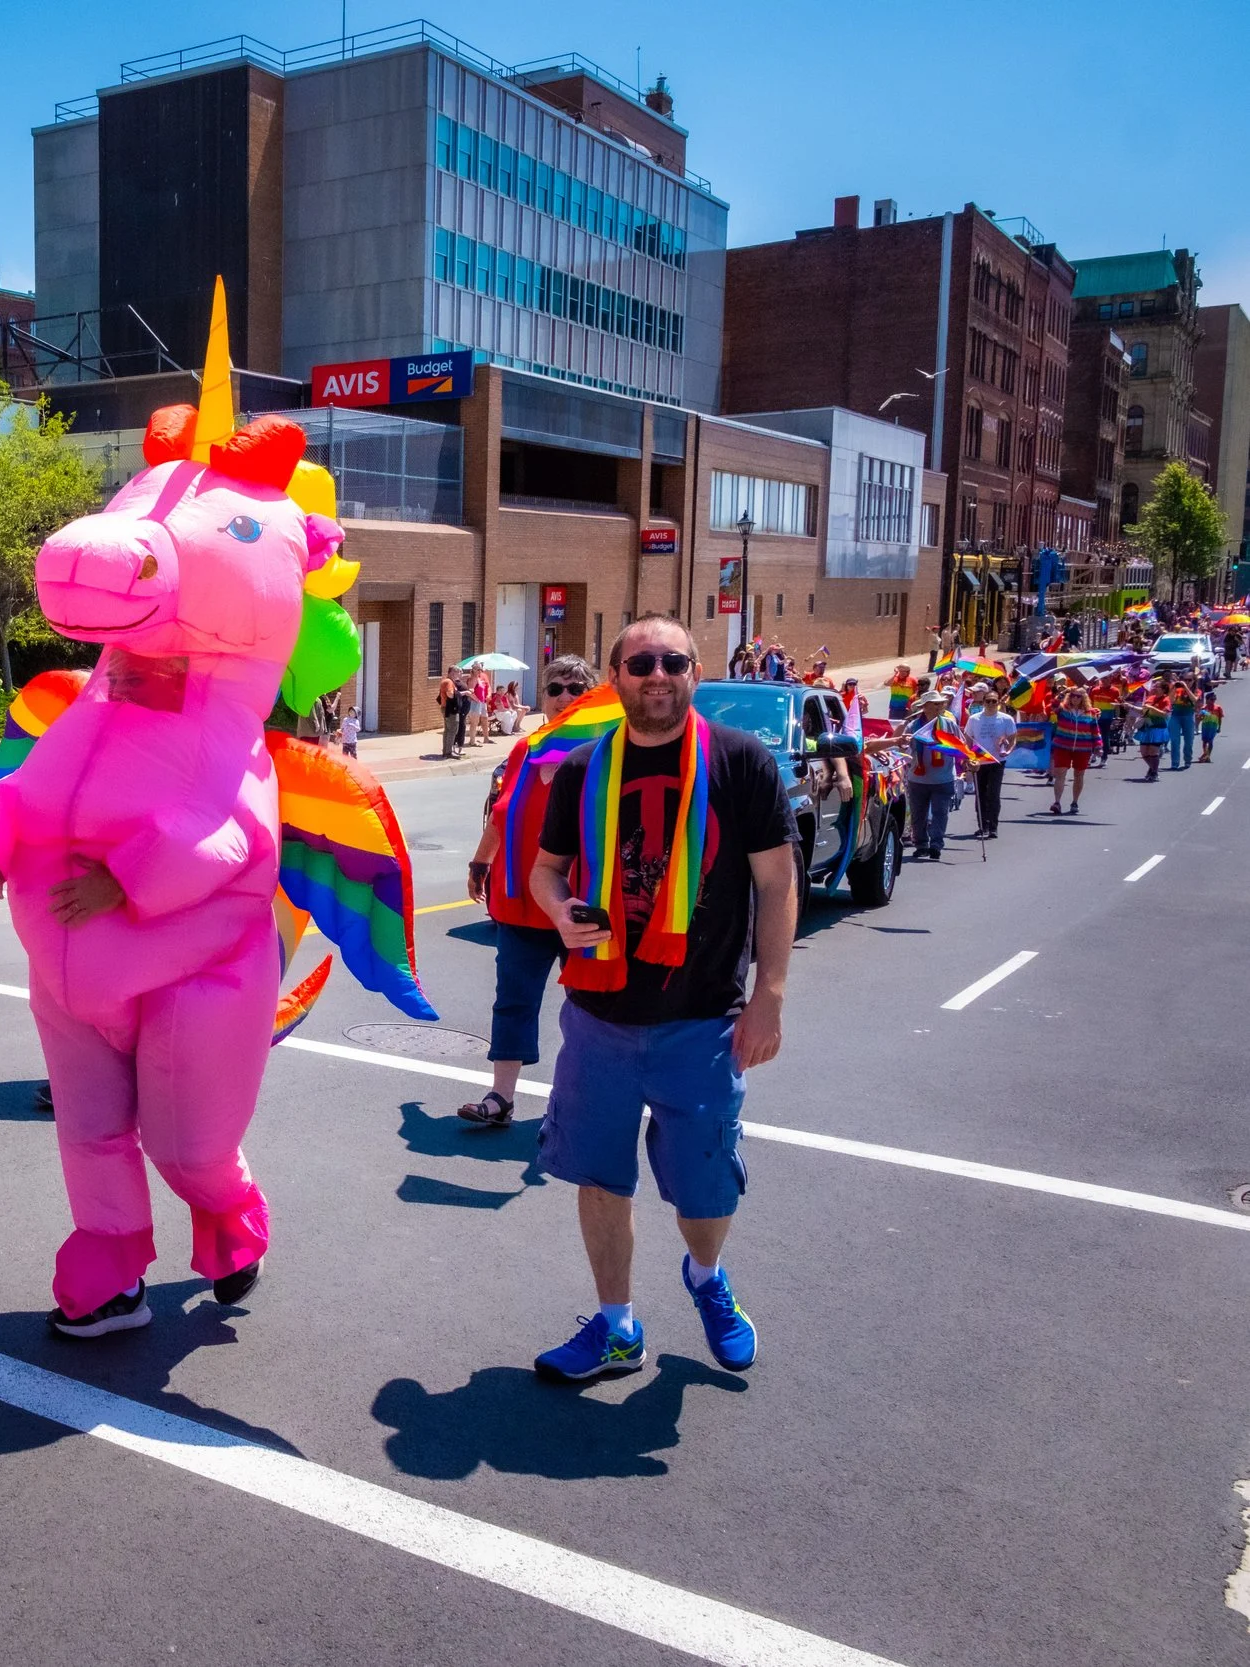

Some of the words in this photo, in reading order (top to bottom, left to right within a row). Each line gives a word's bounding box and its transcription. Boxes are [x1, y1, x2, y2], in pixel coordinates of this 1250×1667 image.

[407, 359, 453, 377] Budget
[322, 371, 379, 398] AVIS
[649, 532, 668, 540] AVIS
[651, 543, 674, 551] Budget
[550, 591, 562, 601] AVIS
